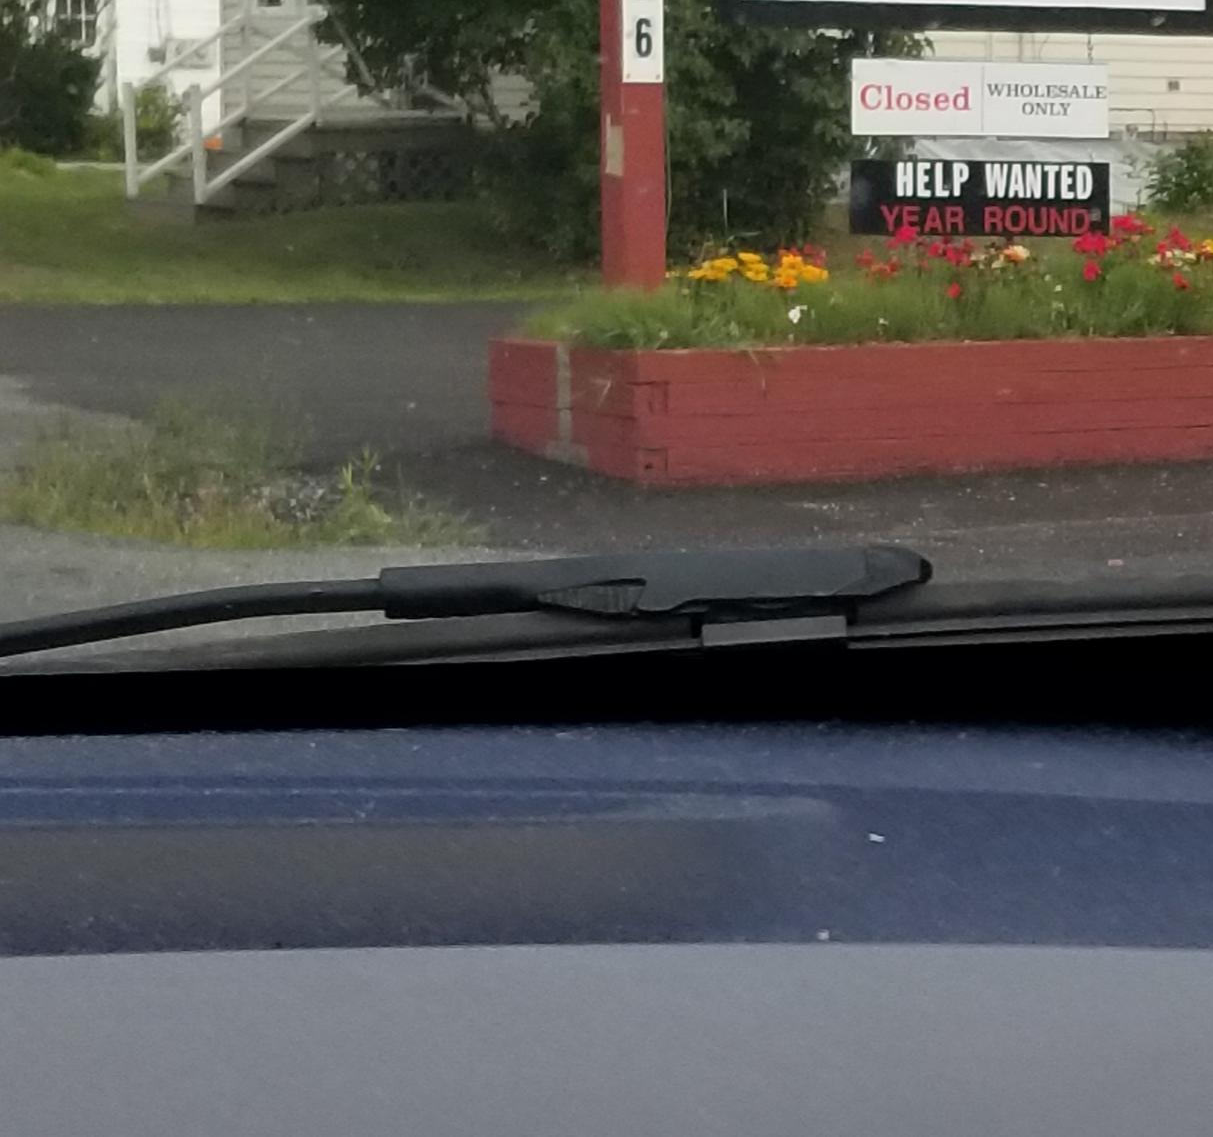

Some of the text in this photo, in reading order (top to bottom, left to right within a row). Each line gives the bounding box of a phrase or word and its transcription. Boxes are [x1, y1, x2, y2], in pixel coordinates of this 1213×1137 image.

[859, 84, 972, 111] Closed
[987, 83, 1108, 100] WHOLESALE
[1021, 102, 1072, 117] ONLY
[896, 162, 1094, 199] HELP WANTED
[880, 205, 1092, 233] YEAR ROUND
